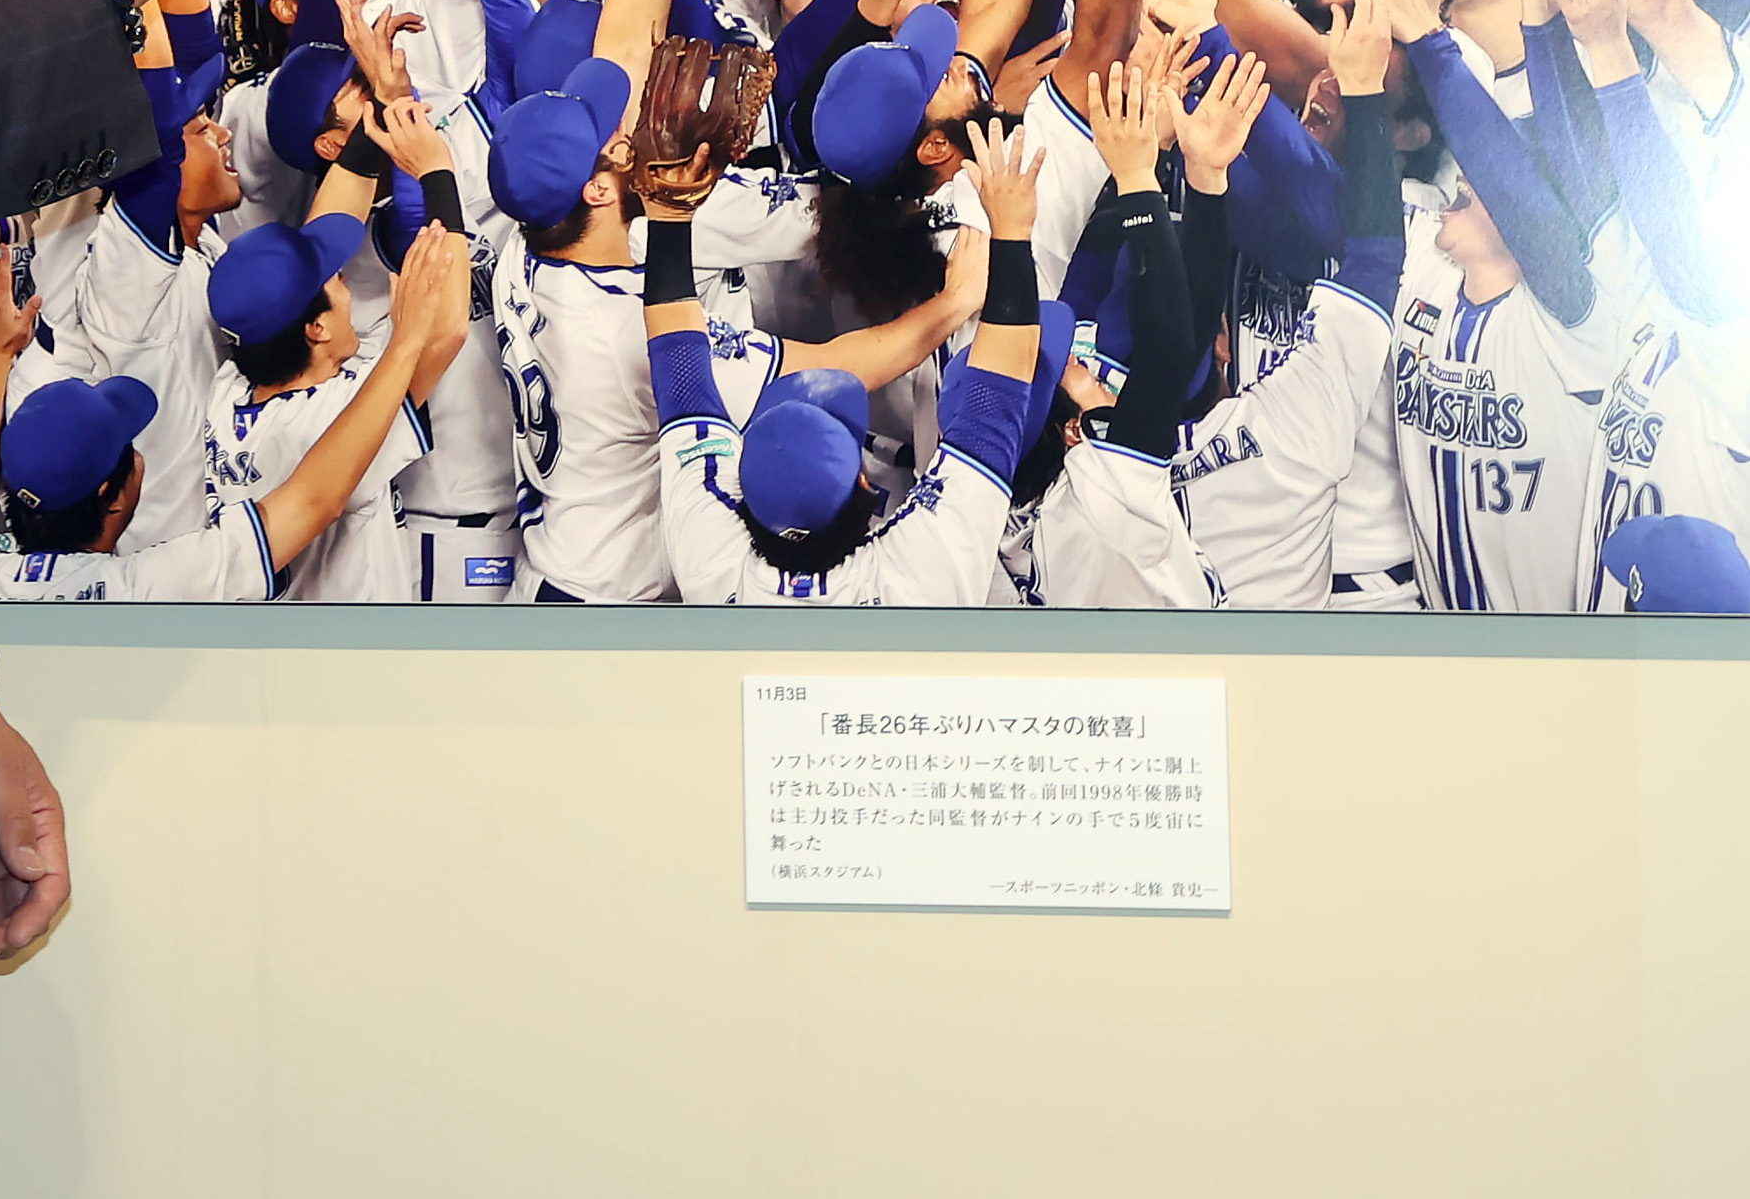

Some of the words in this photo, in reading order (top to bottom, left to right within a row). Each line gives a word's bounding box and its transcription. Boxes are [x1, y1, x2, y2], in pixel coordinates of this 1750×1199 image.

[1469, 456, 1546, 515] 137
[756, 685, 807, 702] 11月3日
[820, 711, 1147, 740] 「番長26年ぶりハマスタの歓喜」
[770, 753, 1203, 776] ソフトバンクとの日本シリーズを制して、ナインに胴上
[770, 833, 822, 852] 舞った
